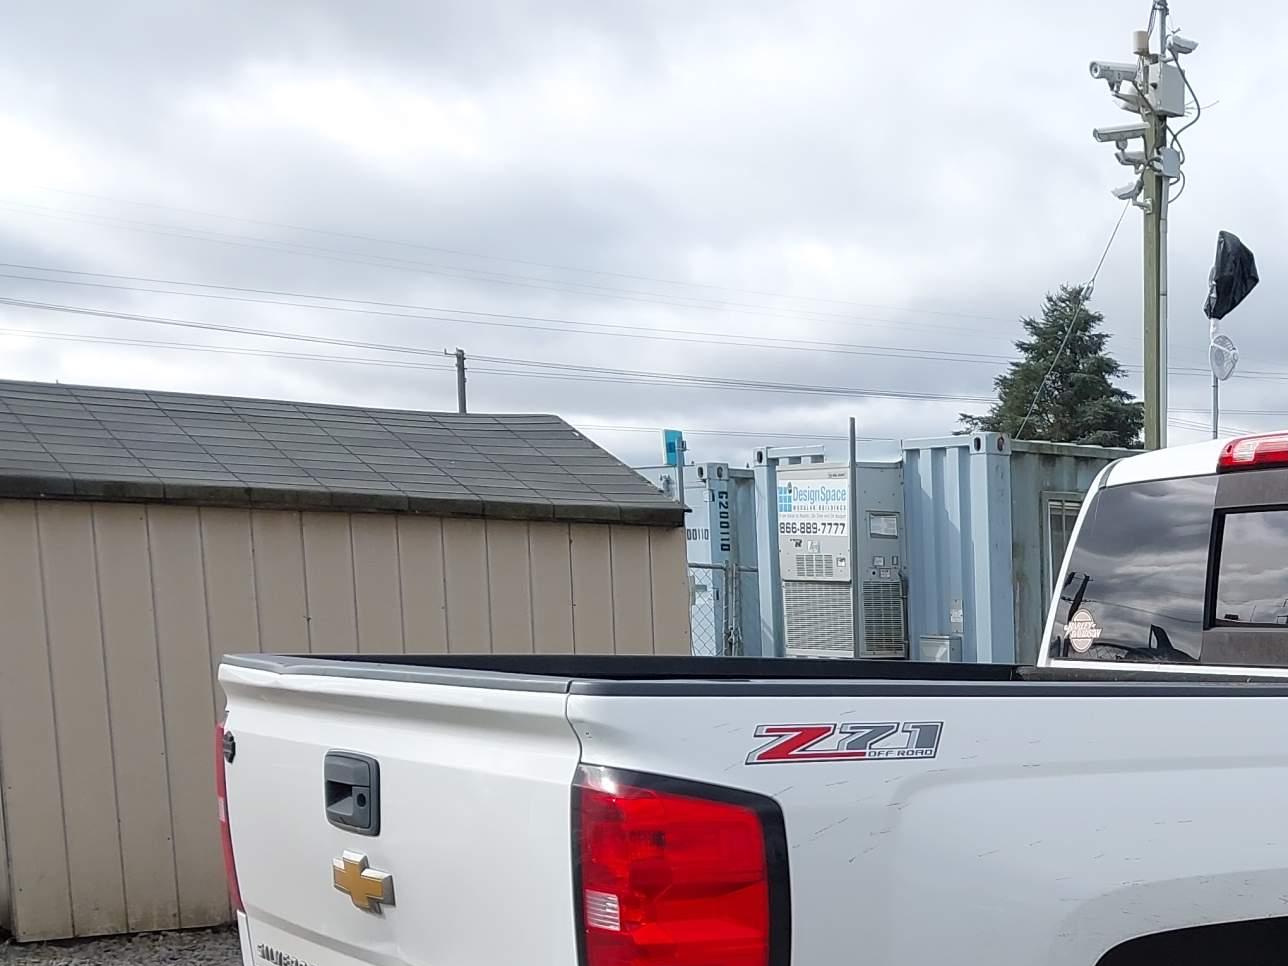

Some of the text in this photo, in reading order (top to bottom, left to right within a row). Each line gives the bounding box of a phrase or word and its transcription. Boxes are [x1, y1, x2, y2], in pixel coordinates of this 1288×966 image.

[793, 485, 846, 504] DesignSpace
[718, 491, 731, 552] G200110
[779, 522, 845, 534] 866-889-7777
[745, 721, 944, 765] Z71
[868, 749, 933, 758] OFF ROAD
